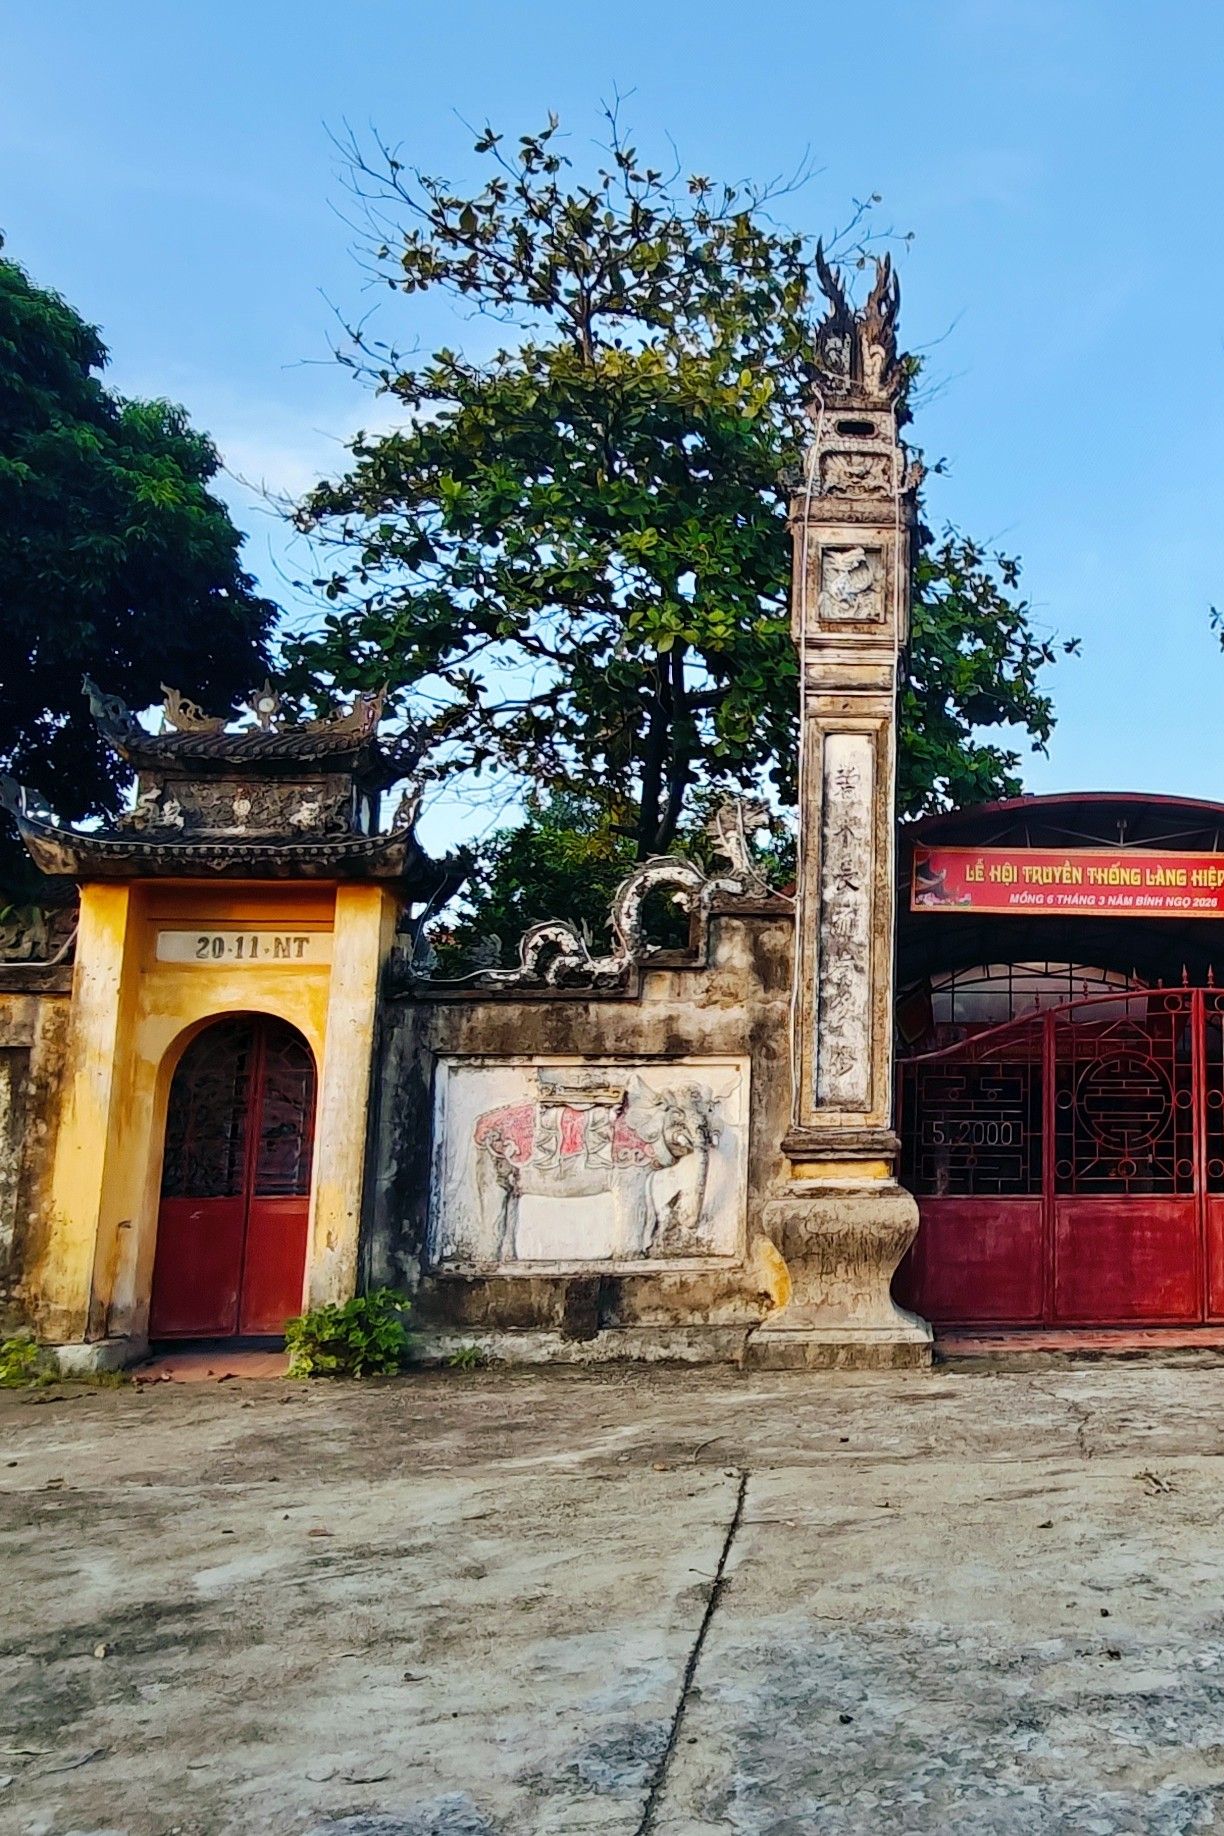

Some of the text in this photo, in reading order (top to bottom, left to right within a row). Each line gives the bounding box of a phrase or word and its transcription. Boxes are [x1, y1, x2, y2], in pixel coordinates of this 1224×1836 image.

[965, 858, 985, 882] LỄ
[989, 862, 1018, 886] HỘI
[1022, 860, 1083, 885] TRUYỀN
[1087, 861, 1142, 886] THỐNG
[1145, 865, 1188, 887] LÀNG
[1046, 895, 1054, 904] 6
[1056, 893, 1096, 905] THÁNG
[1098, 896, 1105, 905] 3
[1107, 894, 1133, 906] NĂM
[1135, 894, 1163, 906] BÍNH
[1165, 897, 1192, 908] NGỌ
[1192, 898, 1218, 907] 2026
